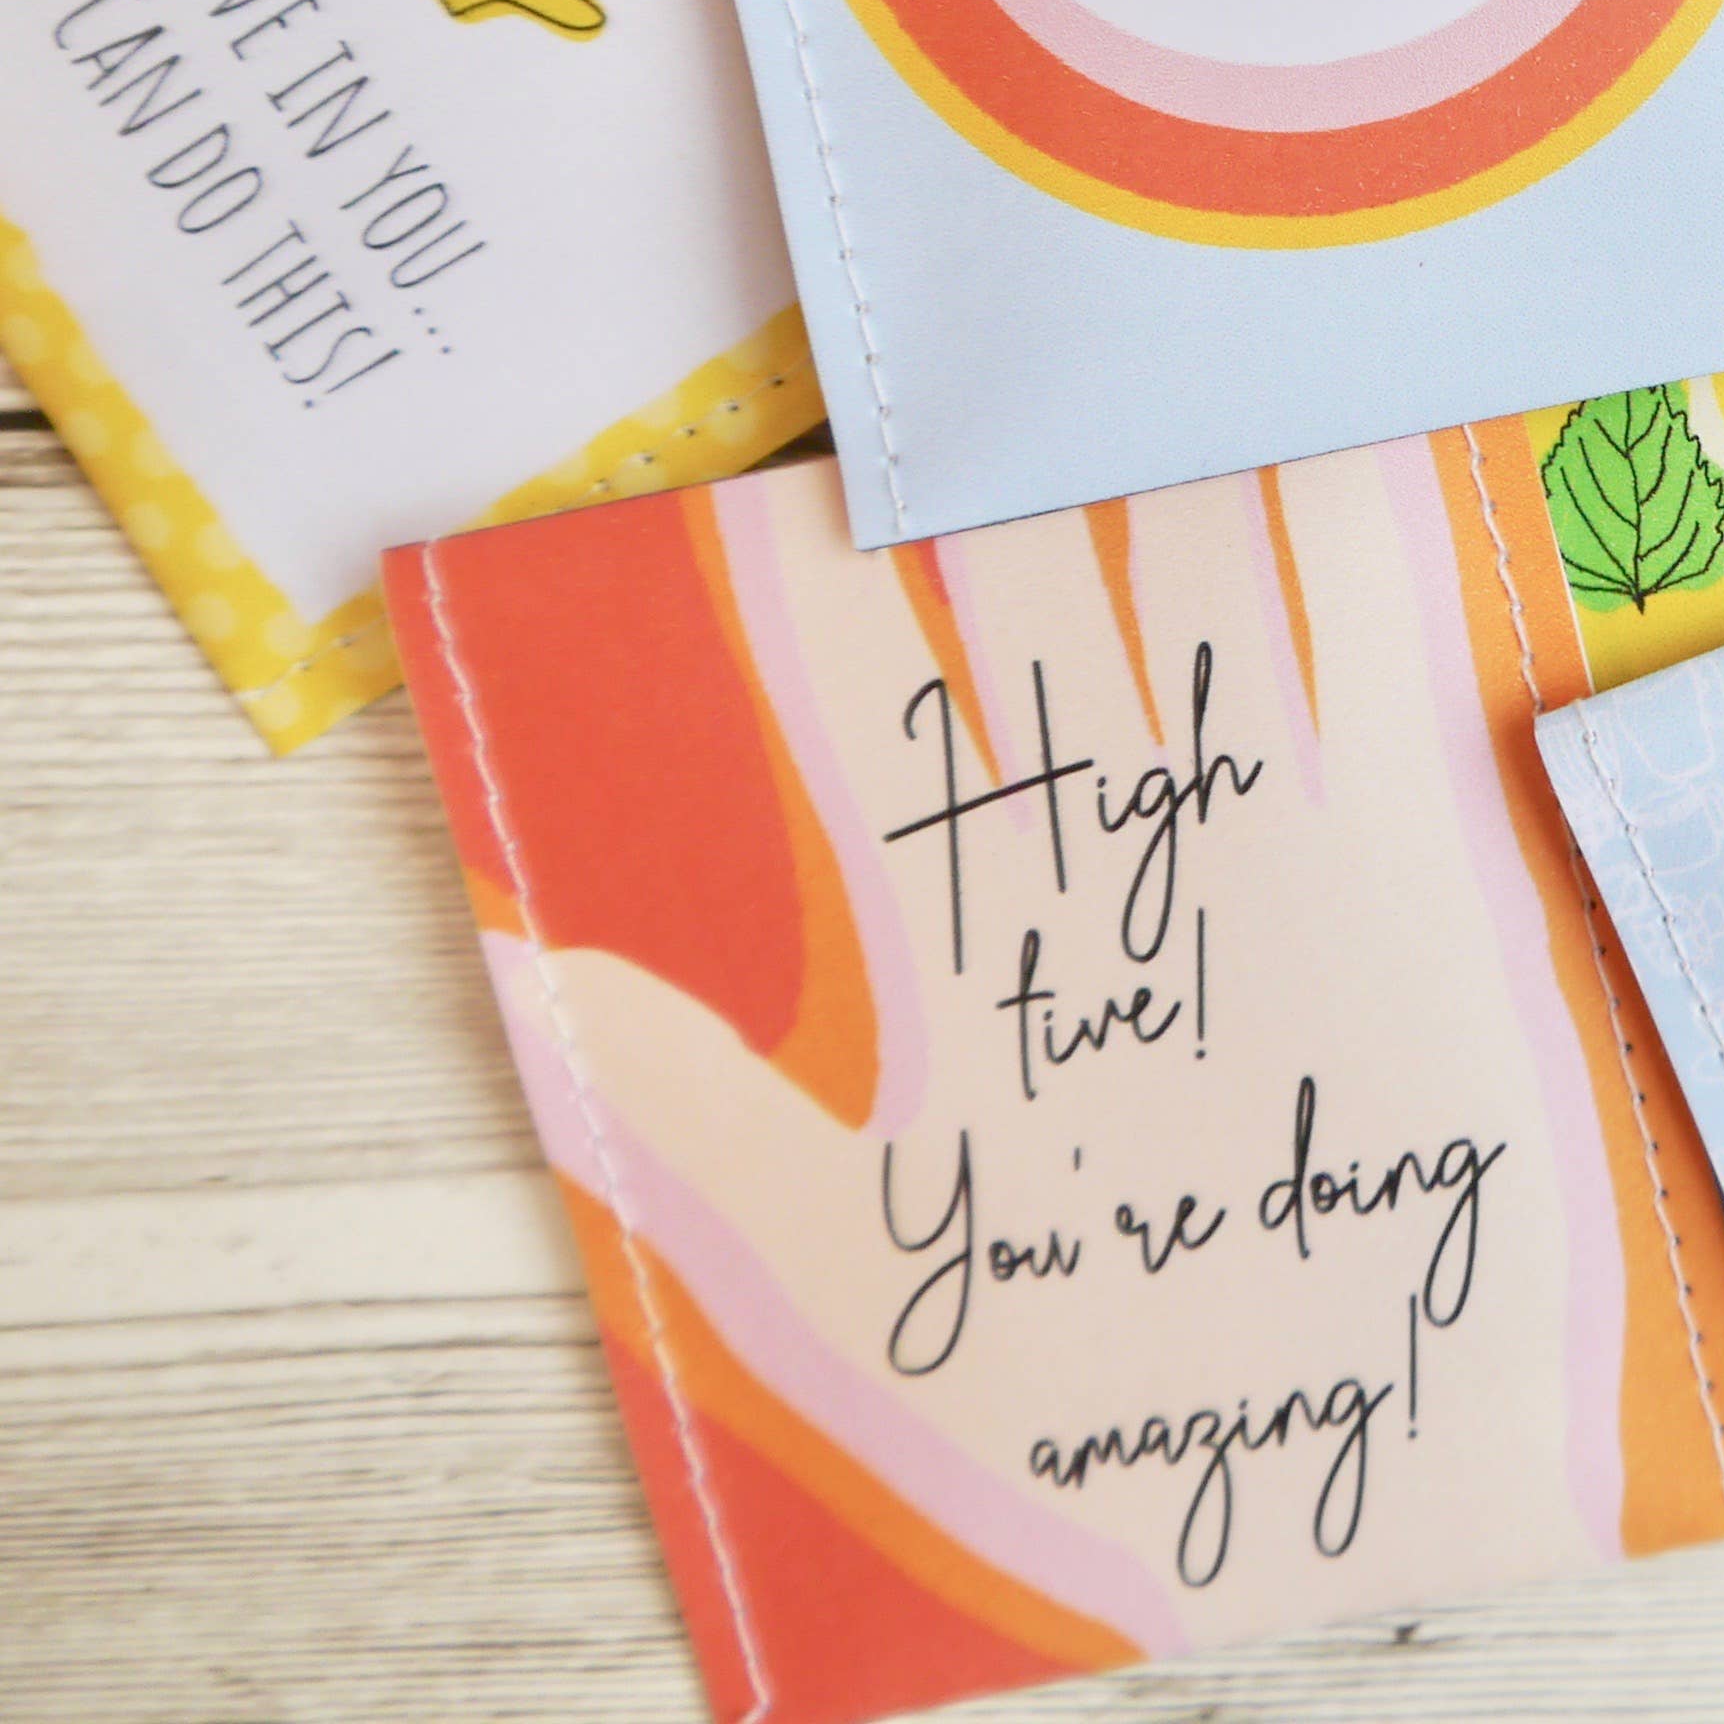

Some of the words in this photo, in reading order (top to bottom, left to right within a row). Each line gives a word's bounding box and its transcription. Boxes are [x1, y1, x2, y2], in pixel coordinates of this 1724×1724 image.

[267, 40, 392, 159] IN
[148, 123, 264, 234] DO
[221, 219, 402, 409] THIS!
[883, 640, 1263, 974] High
[881, 1130, 1224, 1375] You're
[1258, 1077, 1508, 1328] doing
[1031, 1293, 1420, 1587] amazing!
